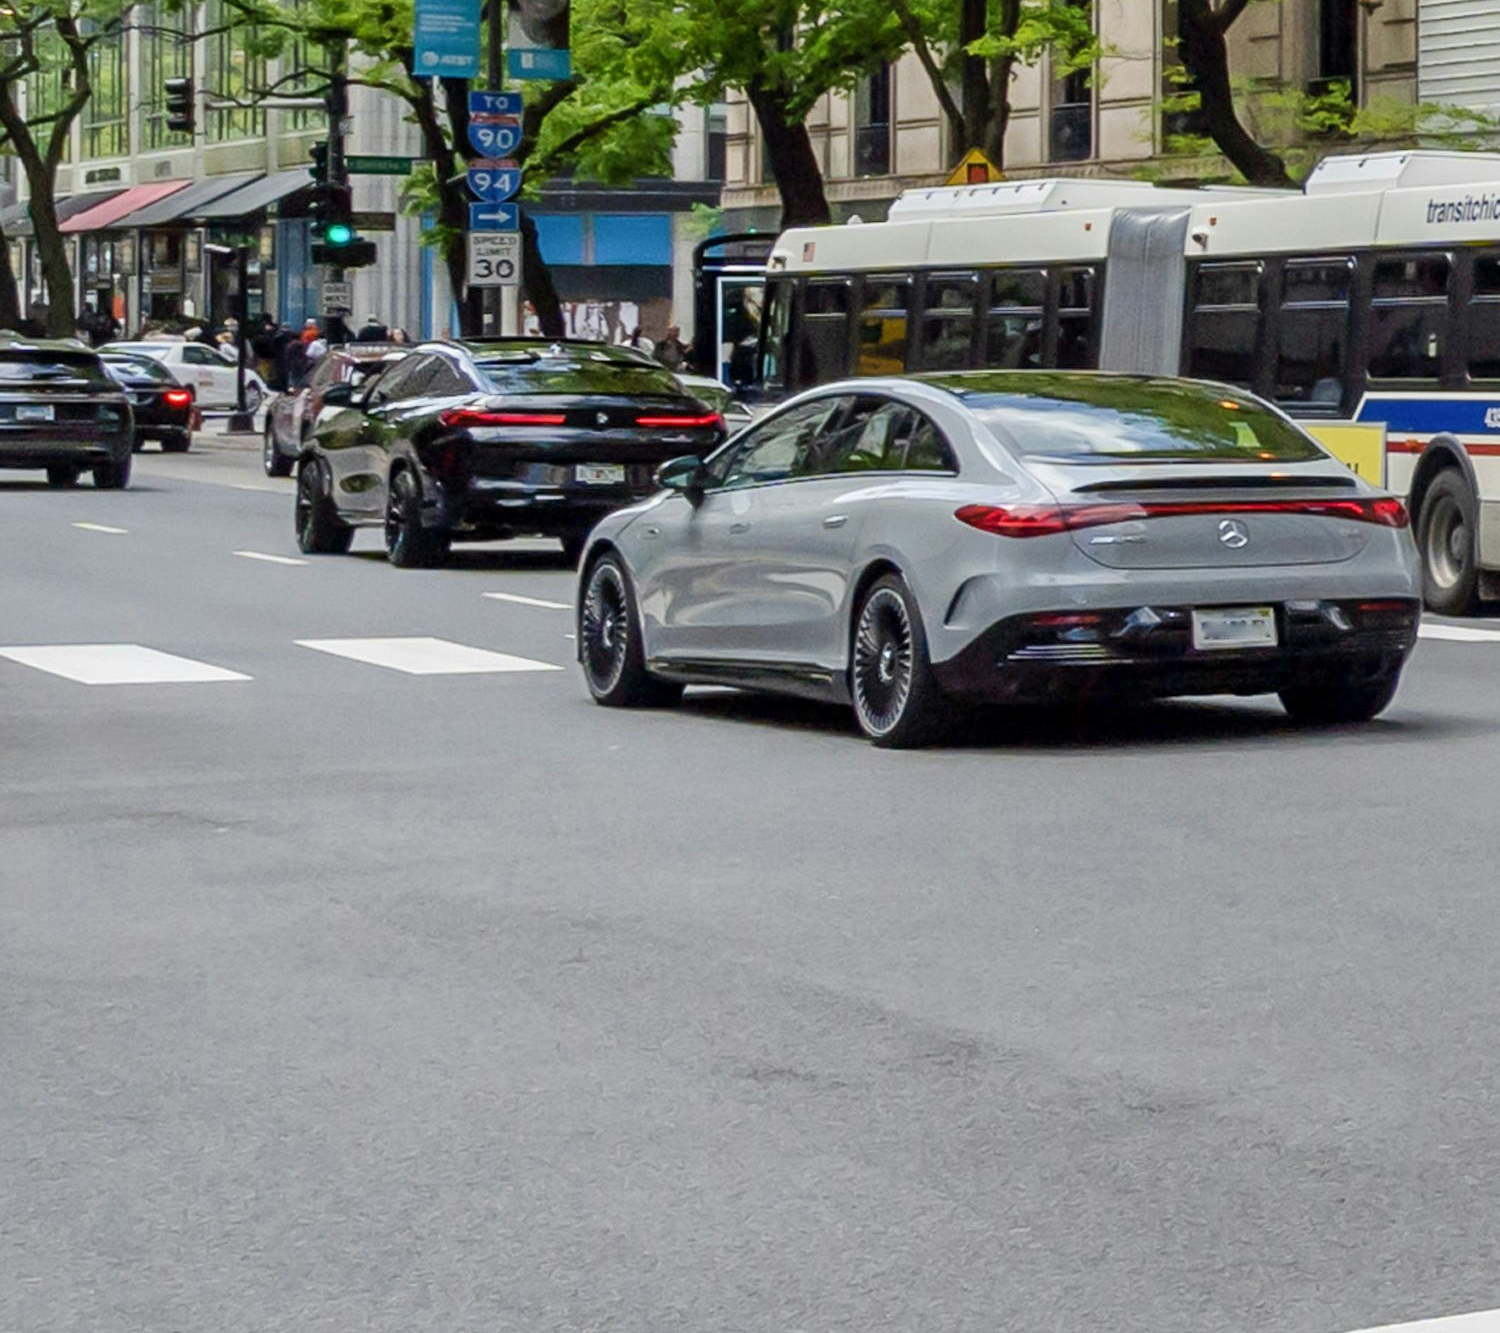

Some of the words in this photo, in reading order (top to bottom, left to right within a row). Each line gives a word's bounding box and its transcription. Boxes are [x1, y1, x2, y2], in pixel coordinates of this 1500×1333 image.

[482, 95, 510, 110] TO
[476, 128, 515, 149] 90
[473, 172, 512, 193] 94
[473, 259, 514, 278] 30
